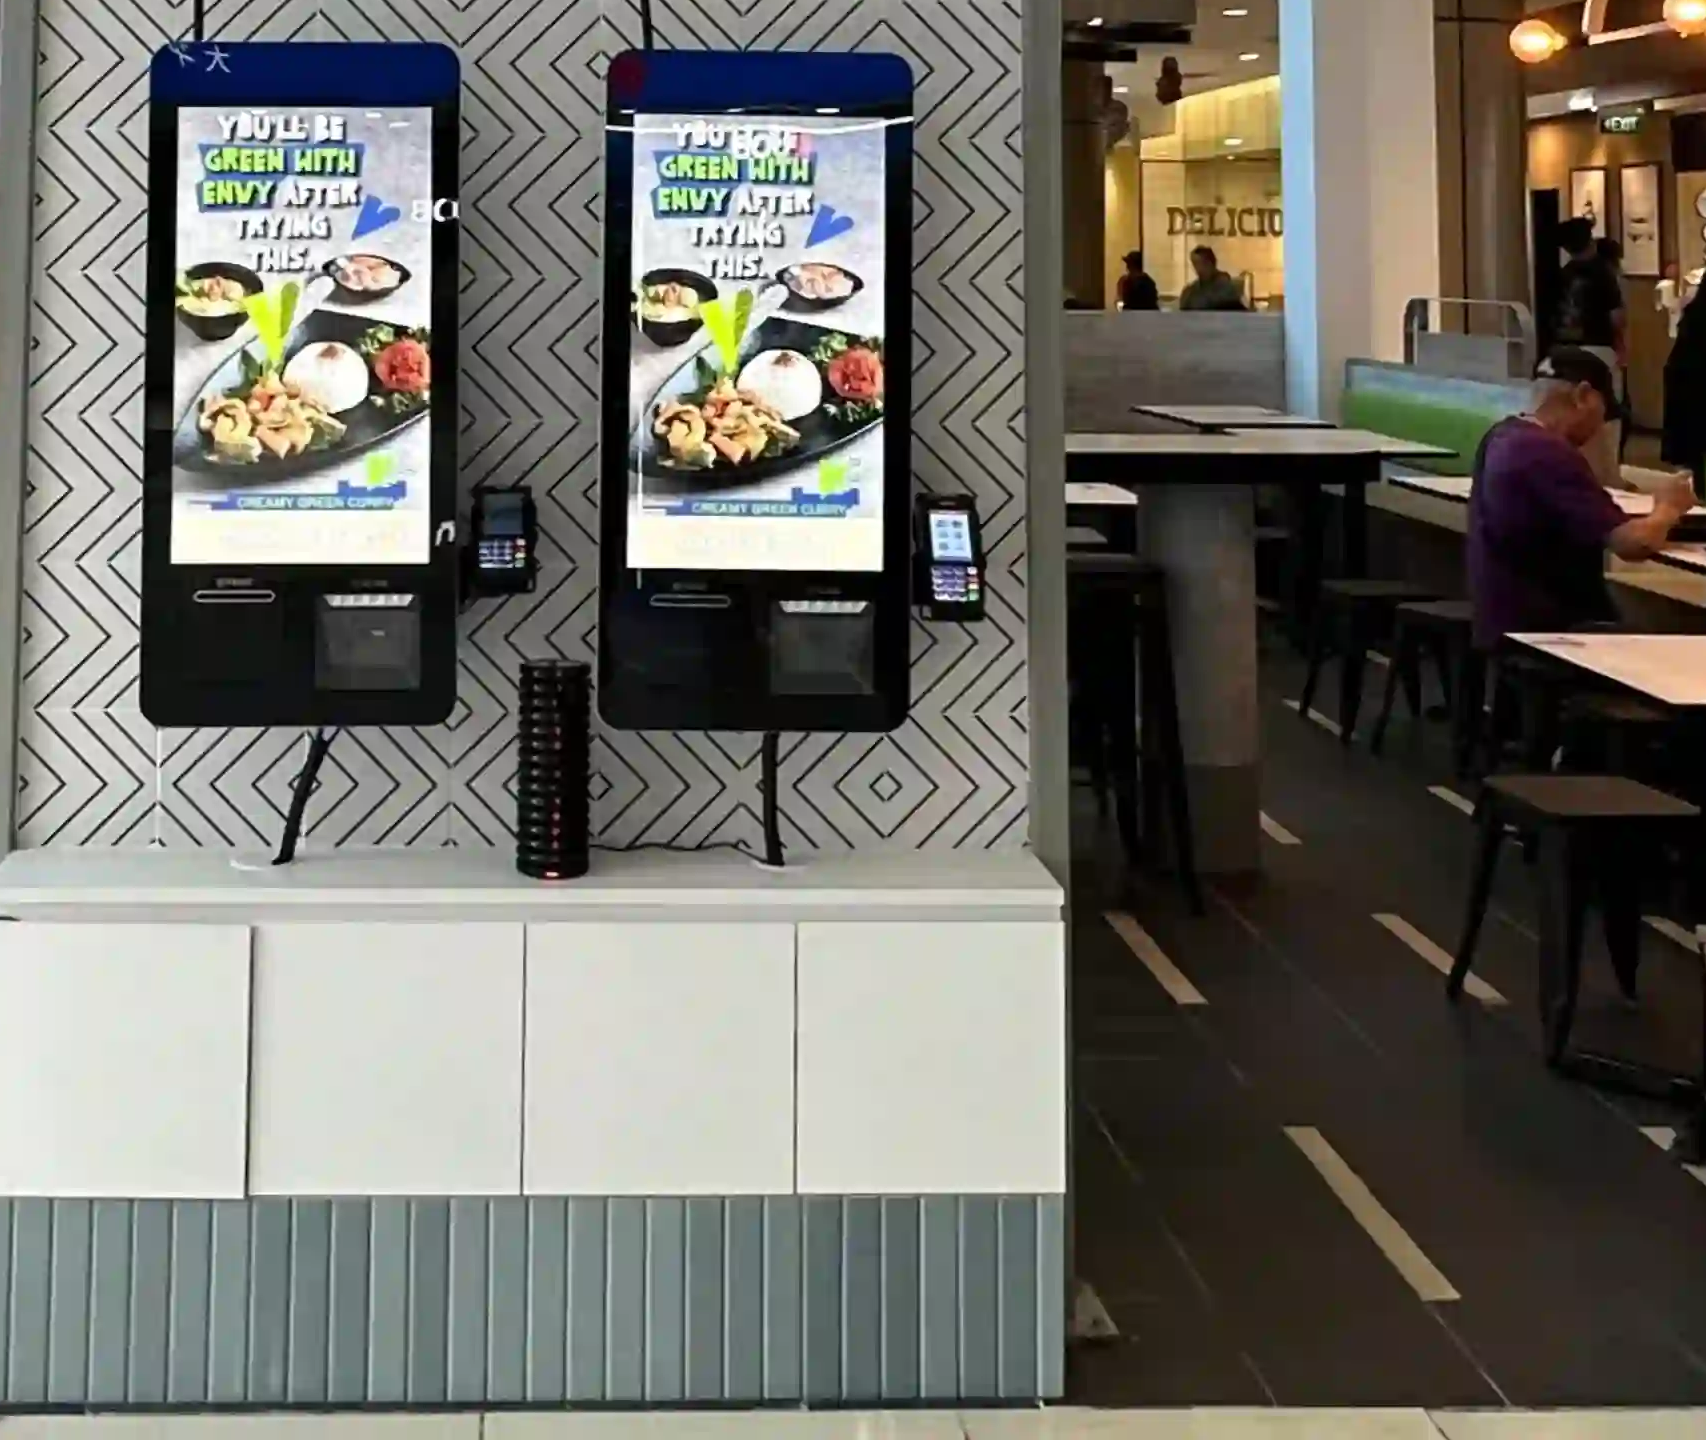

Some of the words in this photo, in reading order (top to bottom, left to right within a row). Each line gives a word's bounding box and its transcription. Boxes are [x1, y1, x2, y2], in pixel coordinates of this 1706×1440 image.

[204, 147, 285, 174] GREEN
[294, 148, 356, 174] WITH
[660, 155, 739, 181] GREEN
[748, 155, 812, 183] WITH
[202, 180, 273, 208] ENVY
[282, 181, 362, 209] AFTER
[657, 187, 728, 214] ENVY
[738, 187, 814, 216] AFTER
